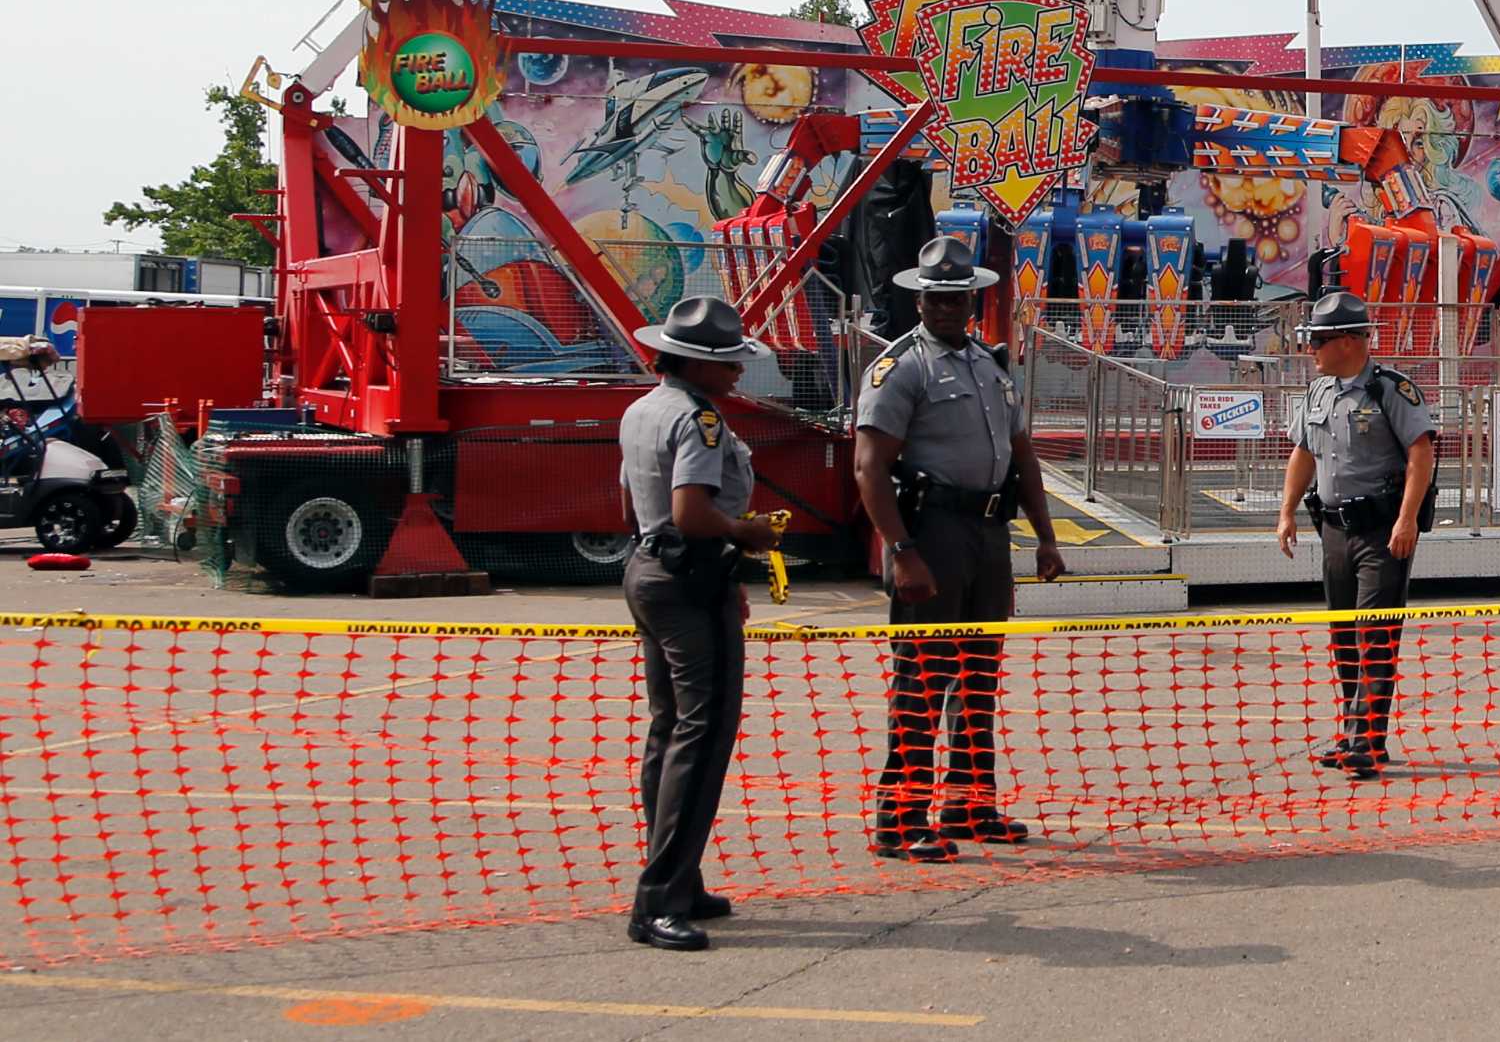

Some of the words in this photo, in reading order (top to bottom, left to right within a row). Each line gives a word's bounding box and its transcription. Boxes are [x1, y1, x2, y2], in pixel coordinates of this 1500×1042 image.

[394, 52, 446, 74] FIRE
[416, 70, 470, 93] BALL
[946, 93, 1090, 191] BALL
[1216, 401, 1256, 423] TICKETS
